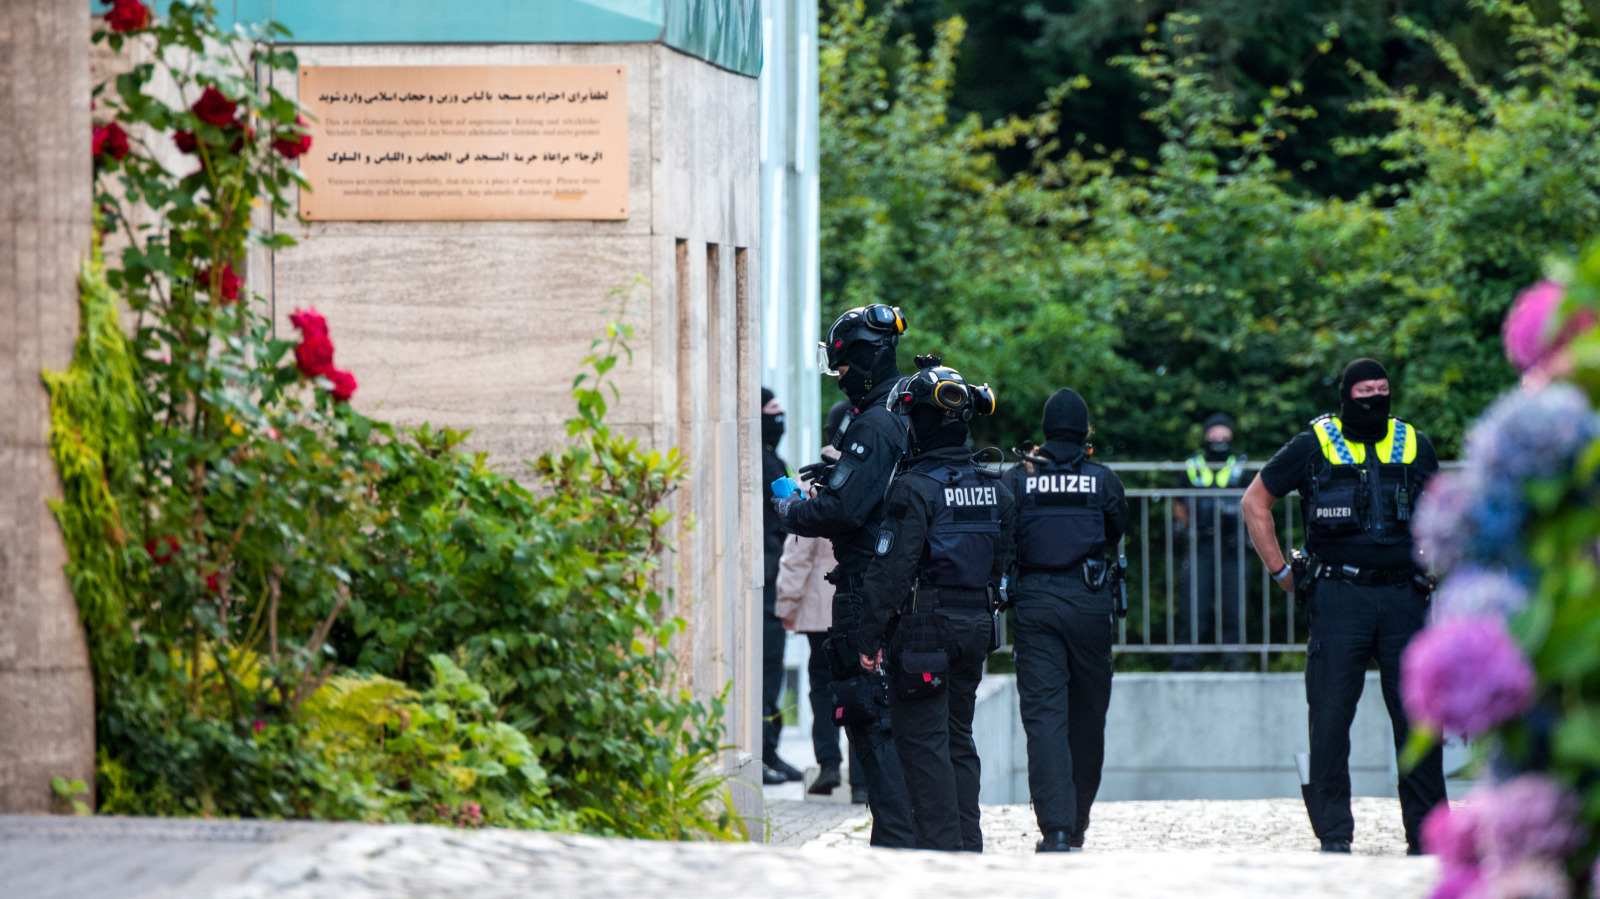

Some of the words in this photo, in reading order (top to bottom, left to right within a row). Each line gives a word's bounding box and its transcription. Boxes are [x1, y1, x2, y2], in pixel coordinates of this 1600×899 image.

[429, 95, 433, 104] و
[499, 93, 522, 103] مسجد
[526, 93, 534, 103] به
[366, 155, 370, 164] و
[408, 155, 412, 164] و
[475, 152, 509, 164] المسجد
[1026, 475, 1097, 494] POLIZEI
[944, 487, 997, 506] POLIZEI
[1316, 507, 1352, 518] POLIZEI
